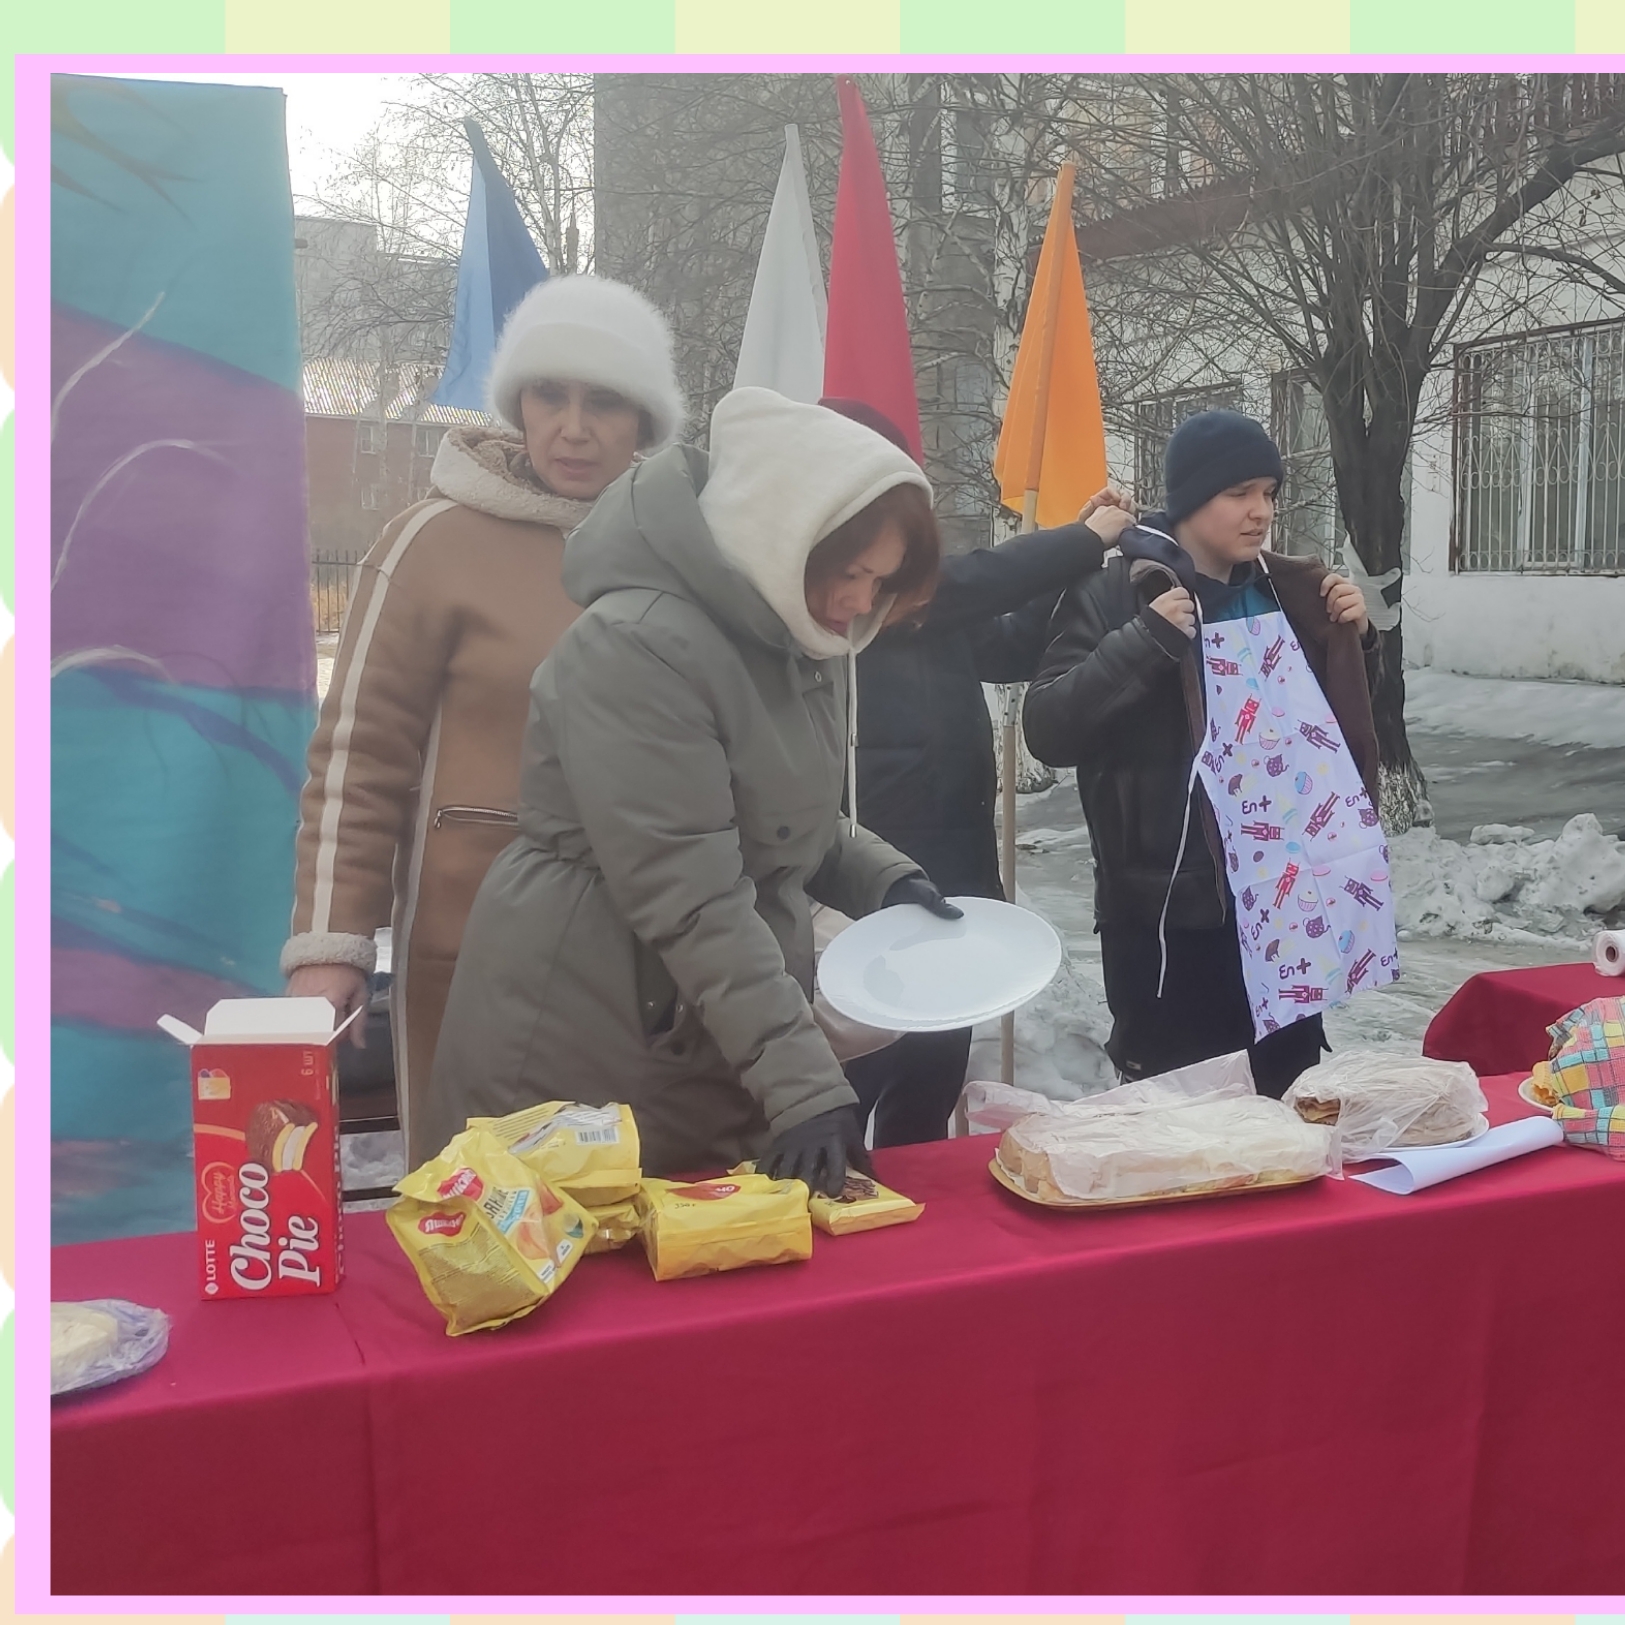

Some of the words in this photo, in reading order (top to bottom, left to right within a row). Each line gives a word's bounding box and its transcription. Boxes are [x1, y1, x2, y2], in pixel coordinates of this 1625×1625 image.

[205, 1239, 217, 1282] LOTTE
[229, 1162, 273, 1291] Choco
[278, 1215, 322, 1288] Pie
